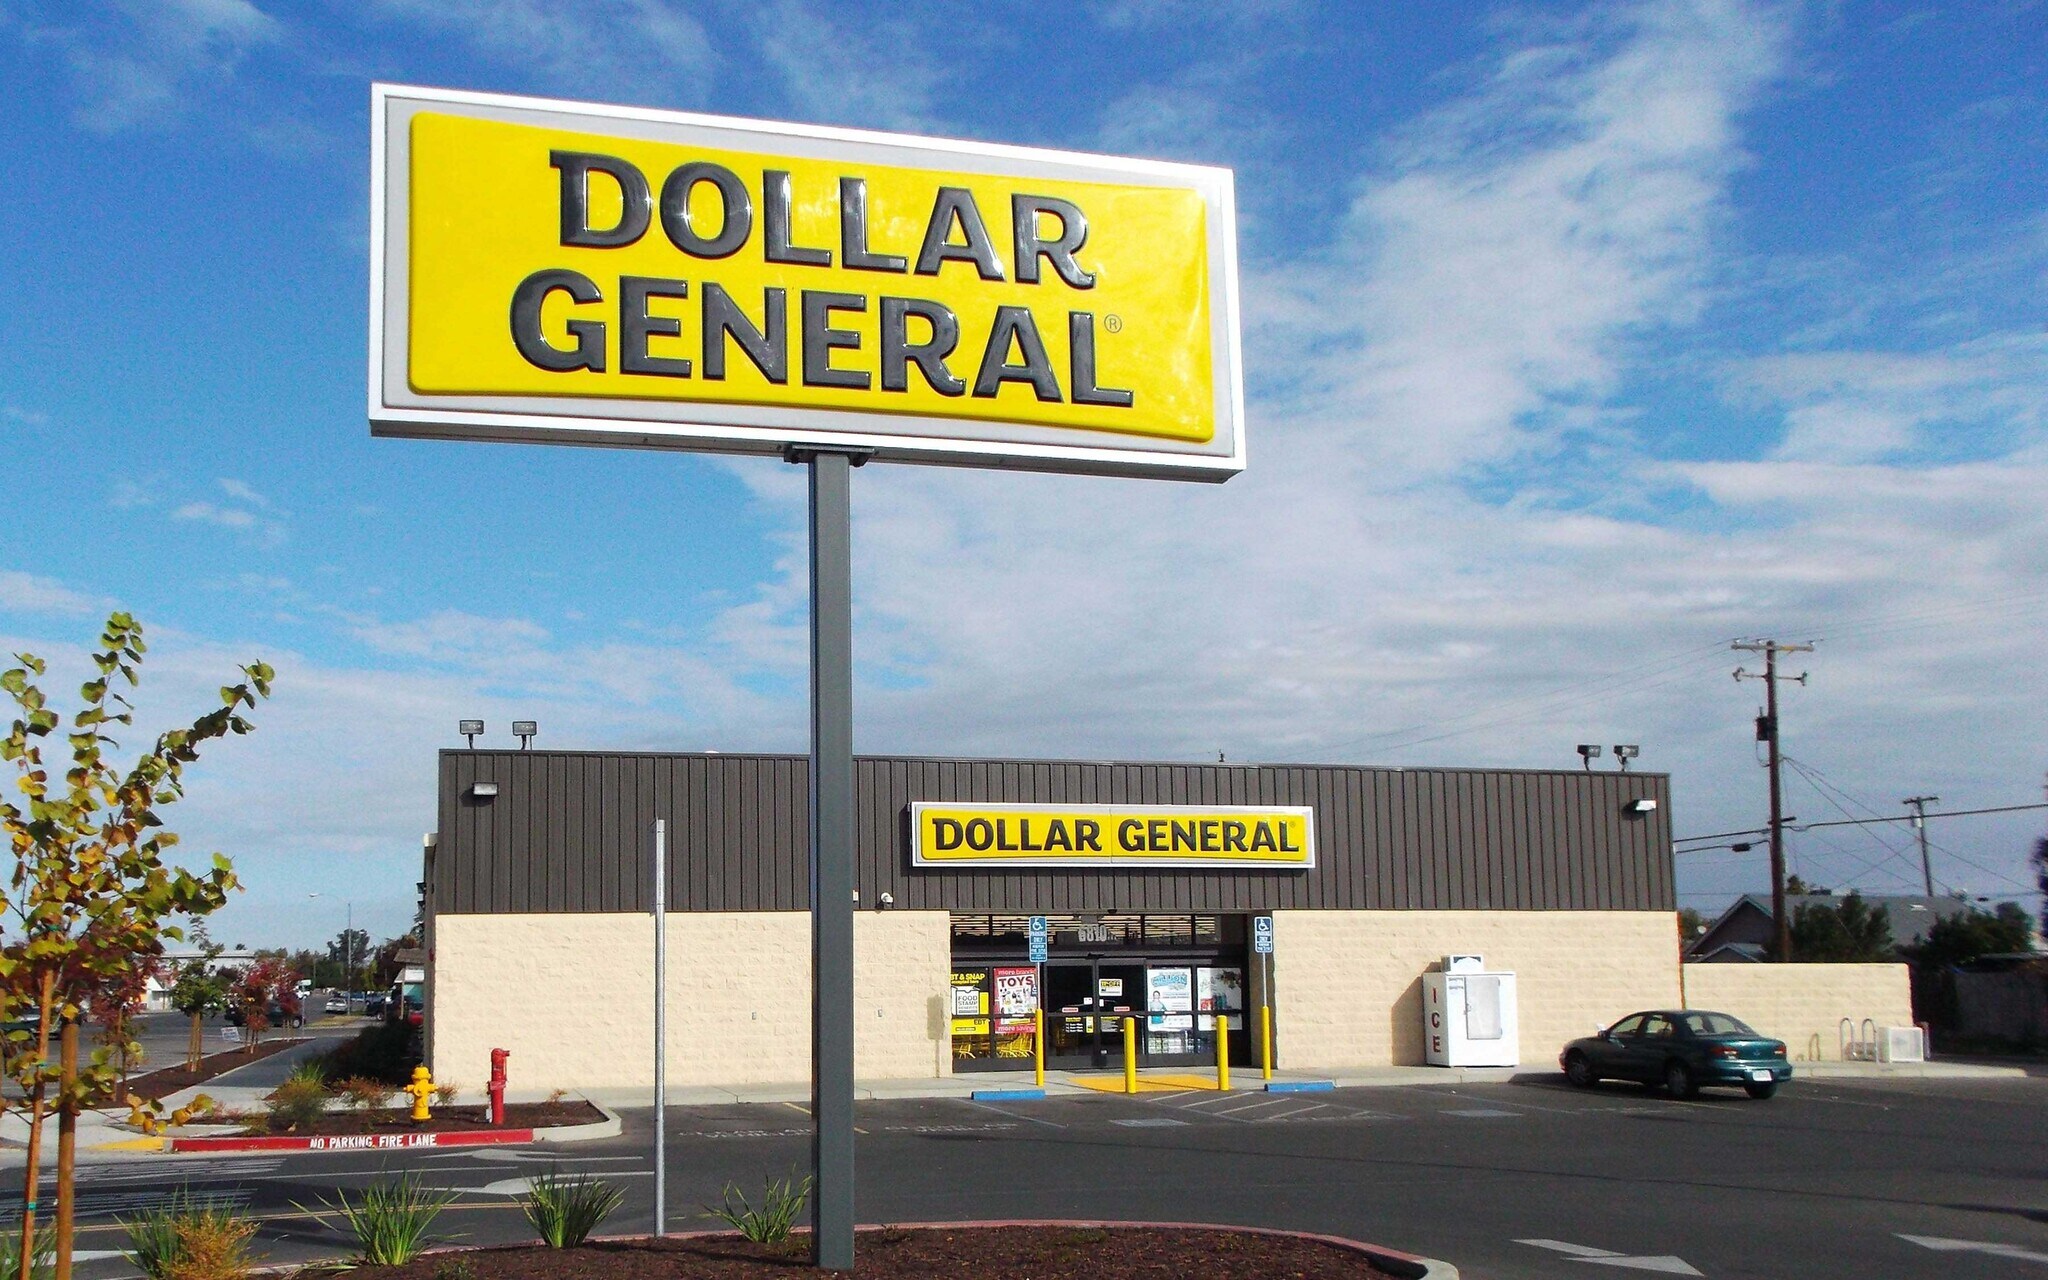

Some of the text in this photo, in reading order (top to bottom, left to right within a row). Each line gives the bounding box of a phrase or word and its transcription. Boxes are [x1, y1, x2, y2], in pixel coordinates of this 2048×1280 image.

[548, 148, 1098, 291] DOLLAR
[508, 267, 1135, 408] GENERAL
[932, 817, 1300, 853] DOLLAR GENERAL
[965, 973, 985, 981] SNAP
[999, 976, 1034, 987] TOYS
[1431, 987, 1442, 1053] ICE
[310, 1134, 437, 1149] NO PARKING FIRE LANE
